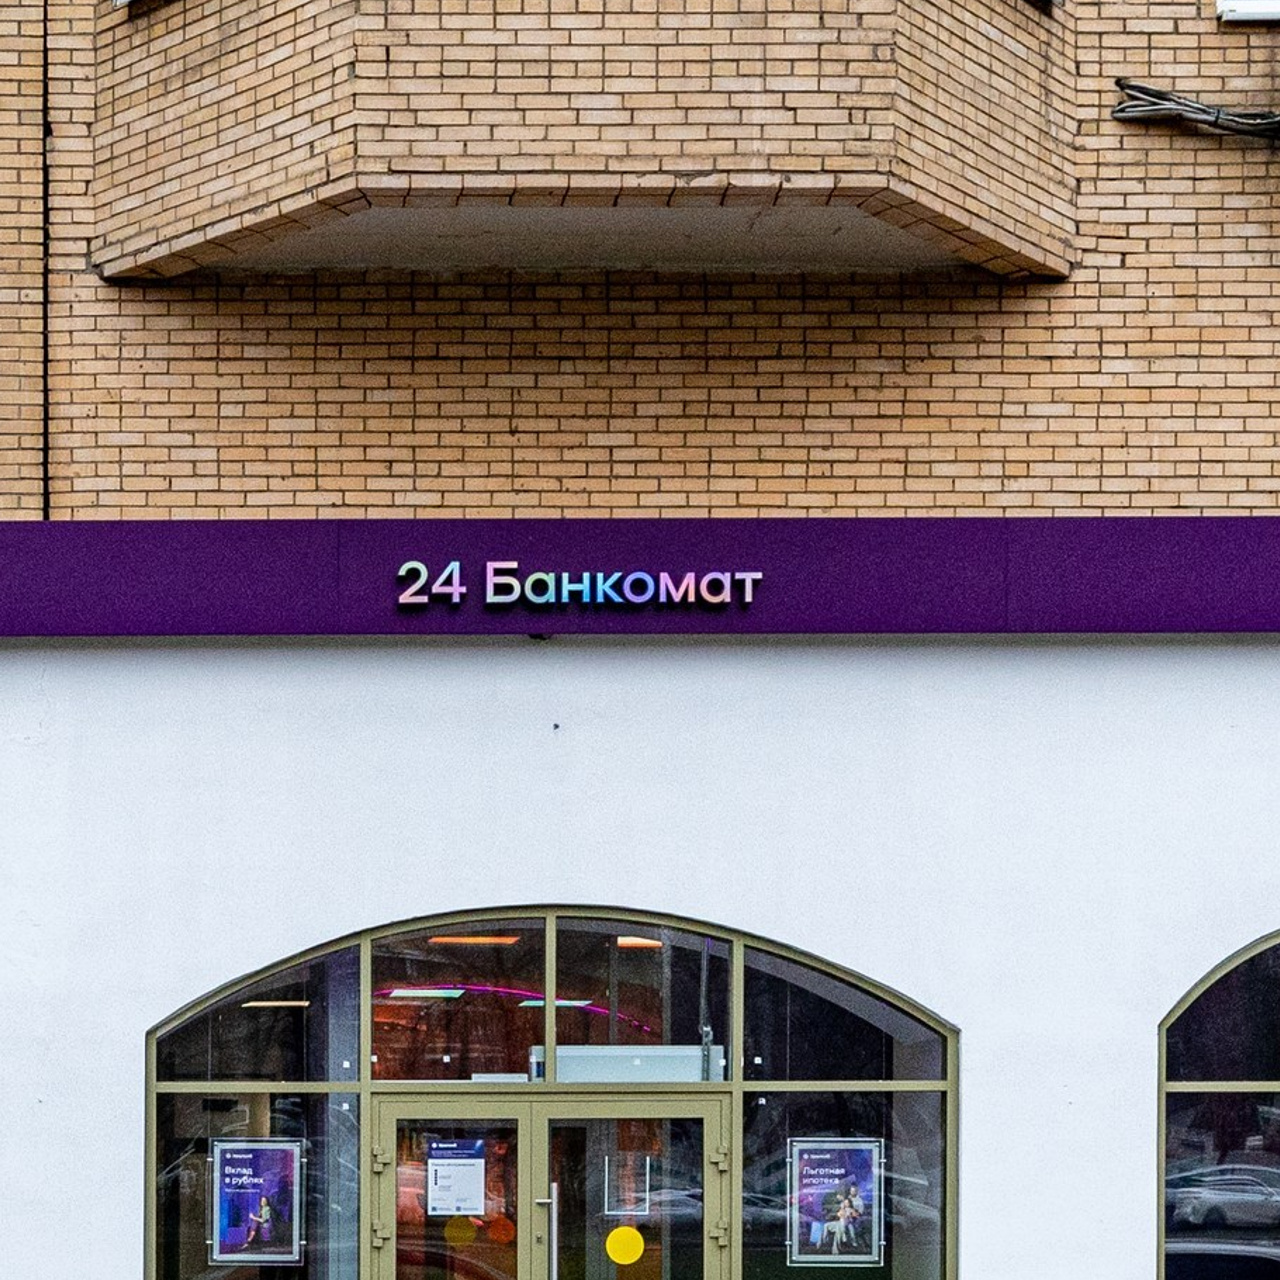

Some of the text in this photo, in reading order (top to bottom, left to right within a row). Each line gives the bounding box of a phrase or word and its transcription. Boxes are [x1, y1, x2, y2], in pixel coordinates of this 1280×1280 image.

[397, 560, 764, 604] 24 Банкомат
[224, 1165, 254, 1176] Вклад
[802, 1166, 846, 1176] Льготная
[231, 1175, 265, 1186] рублях
[802, 1177, 840, 1186] ипотека
